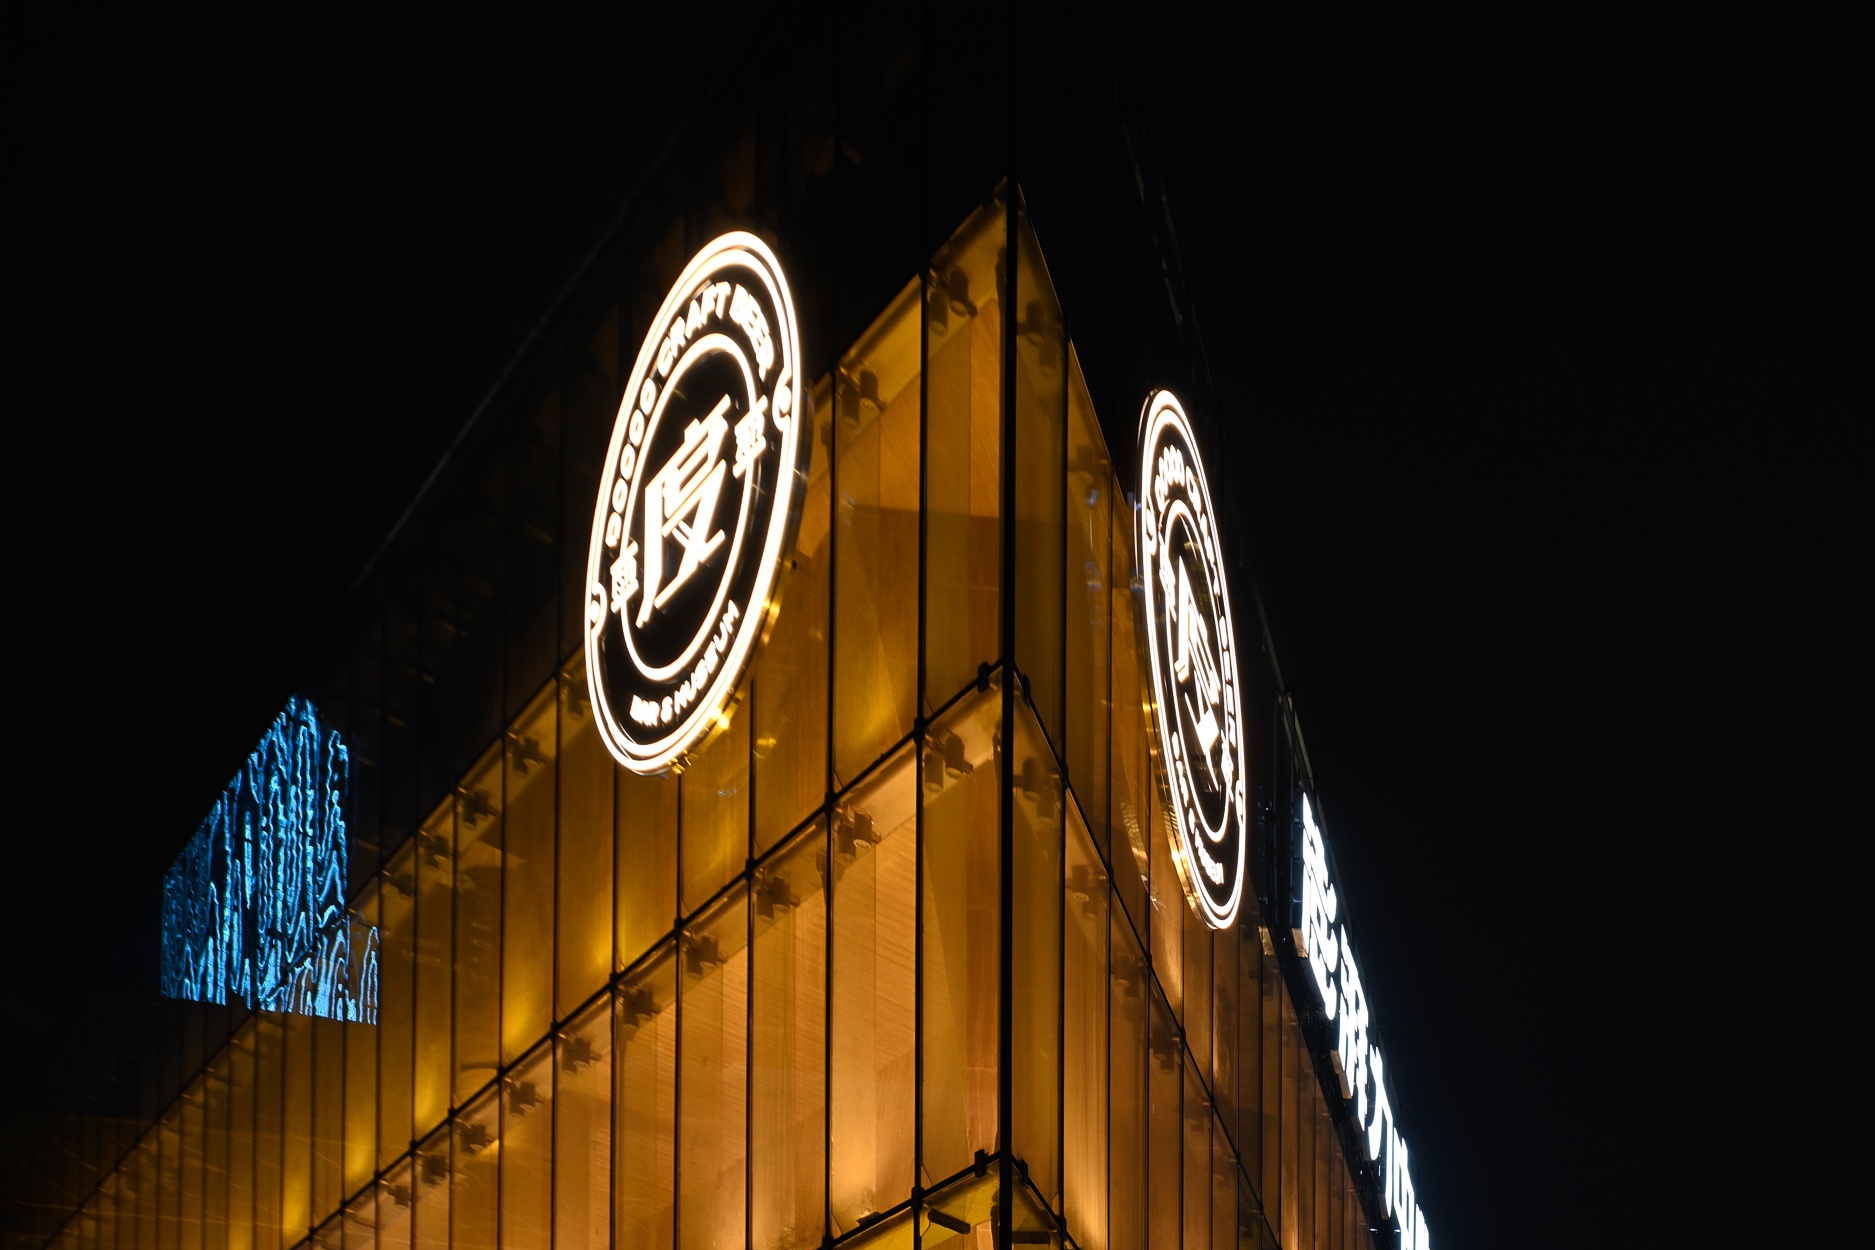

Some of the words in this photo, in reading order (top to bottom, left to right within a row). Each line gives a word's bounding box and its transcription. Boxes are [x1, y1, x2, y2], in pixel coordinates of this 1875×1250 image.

[605, 377, 657, 548] DOOOO
[657, 281, 731, 377] CRAFT
[729, 283, 775, 382] BEER
[673, 600, 740, 711] MUSEUM
